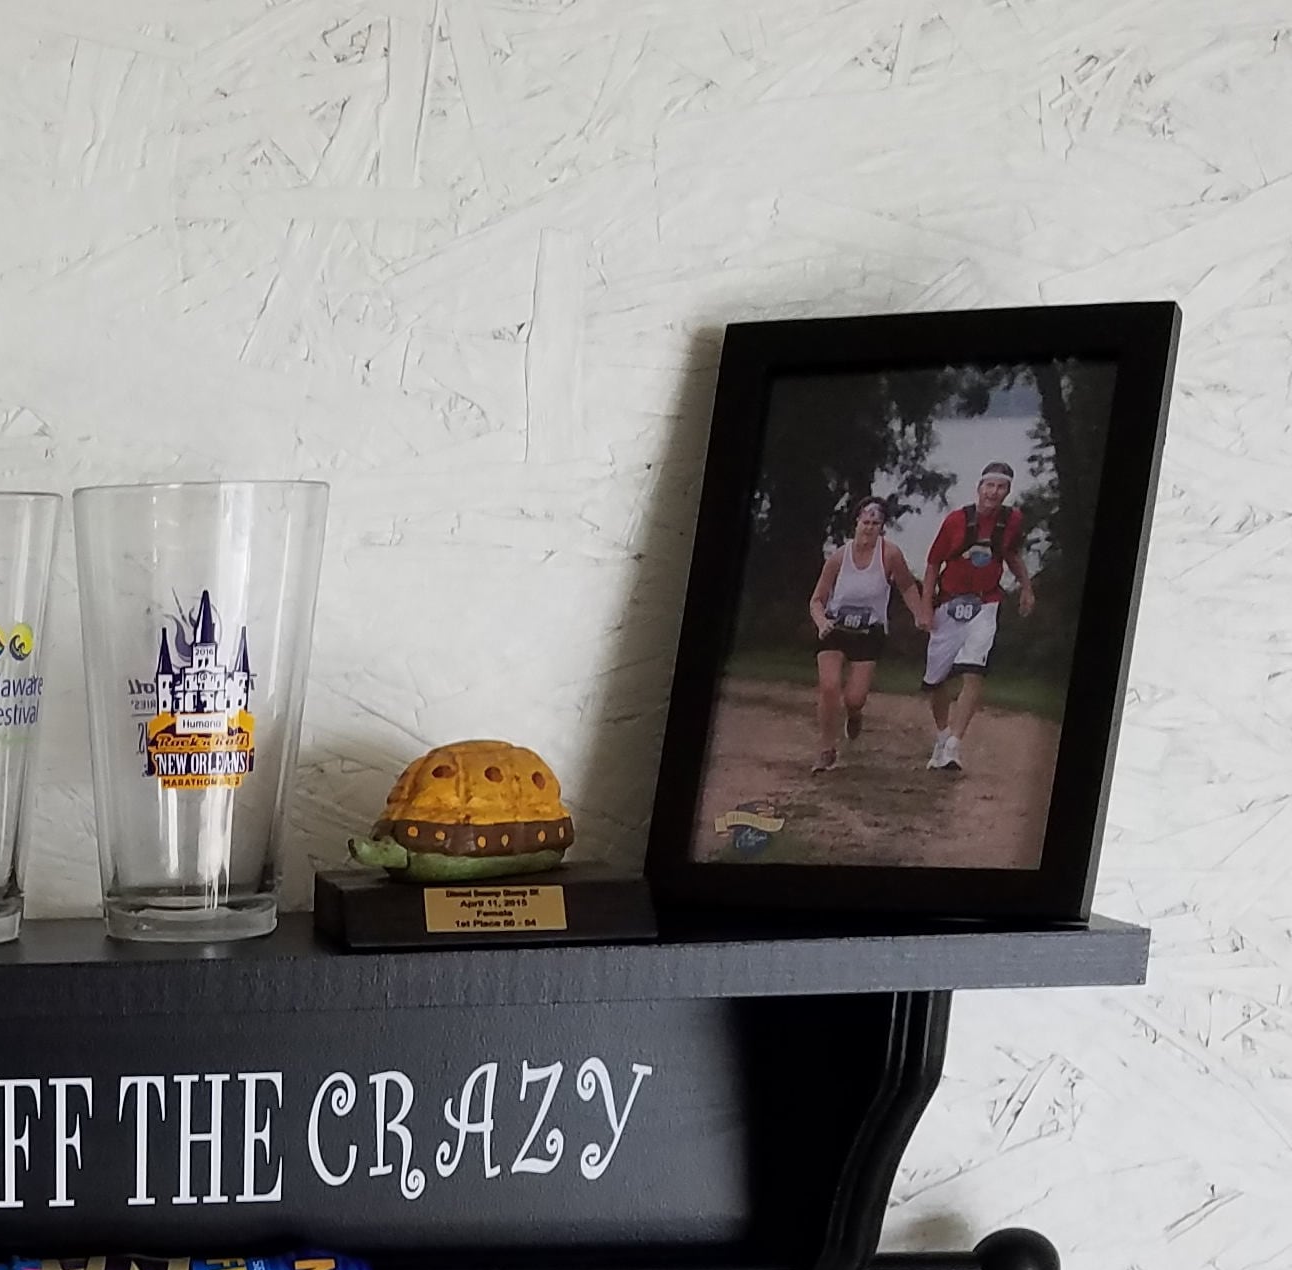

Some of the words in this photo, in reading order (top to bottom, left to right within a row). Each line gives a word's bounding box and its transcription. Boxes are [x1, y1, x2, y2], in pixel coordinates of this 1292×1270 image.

[155, 752, 188, 775] NEW
[190, 751, 246, 775] ORLEANS
[118, 1071, 284, 1206] THE
[308, 1056, 653, 1201] CRAZY
